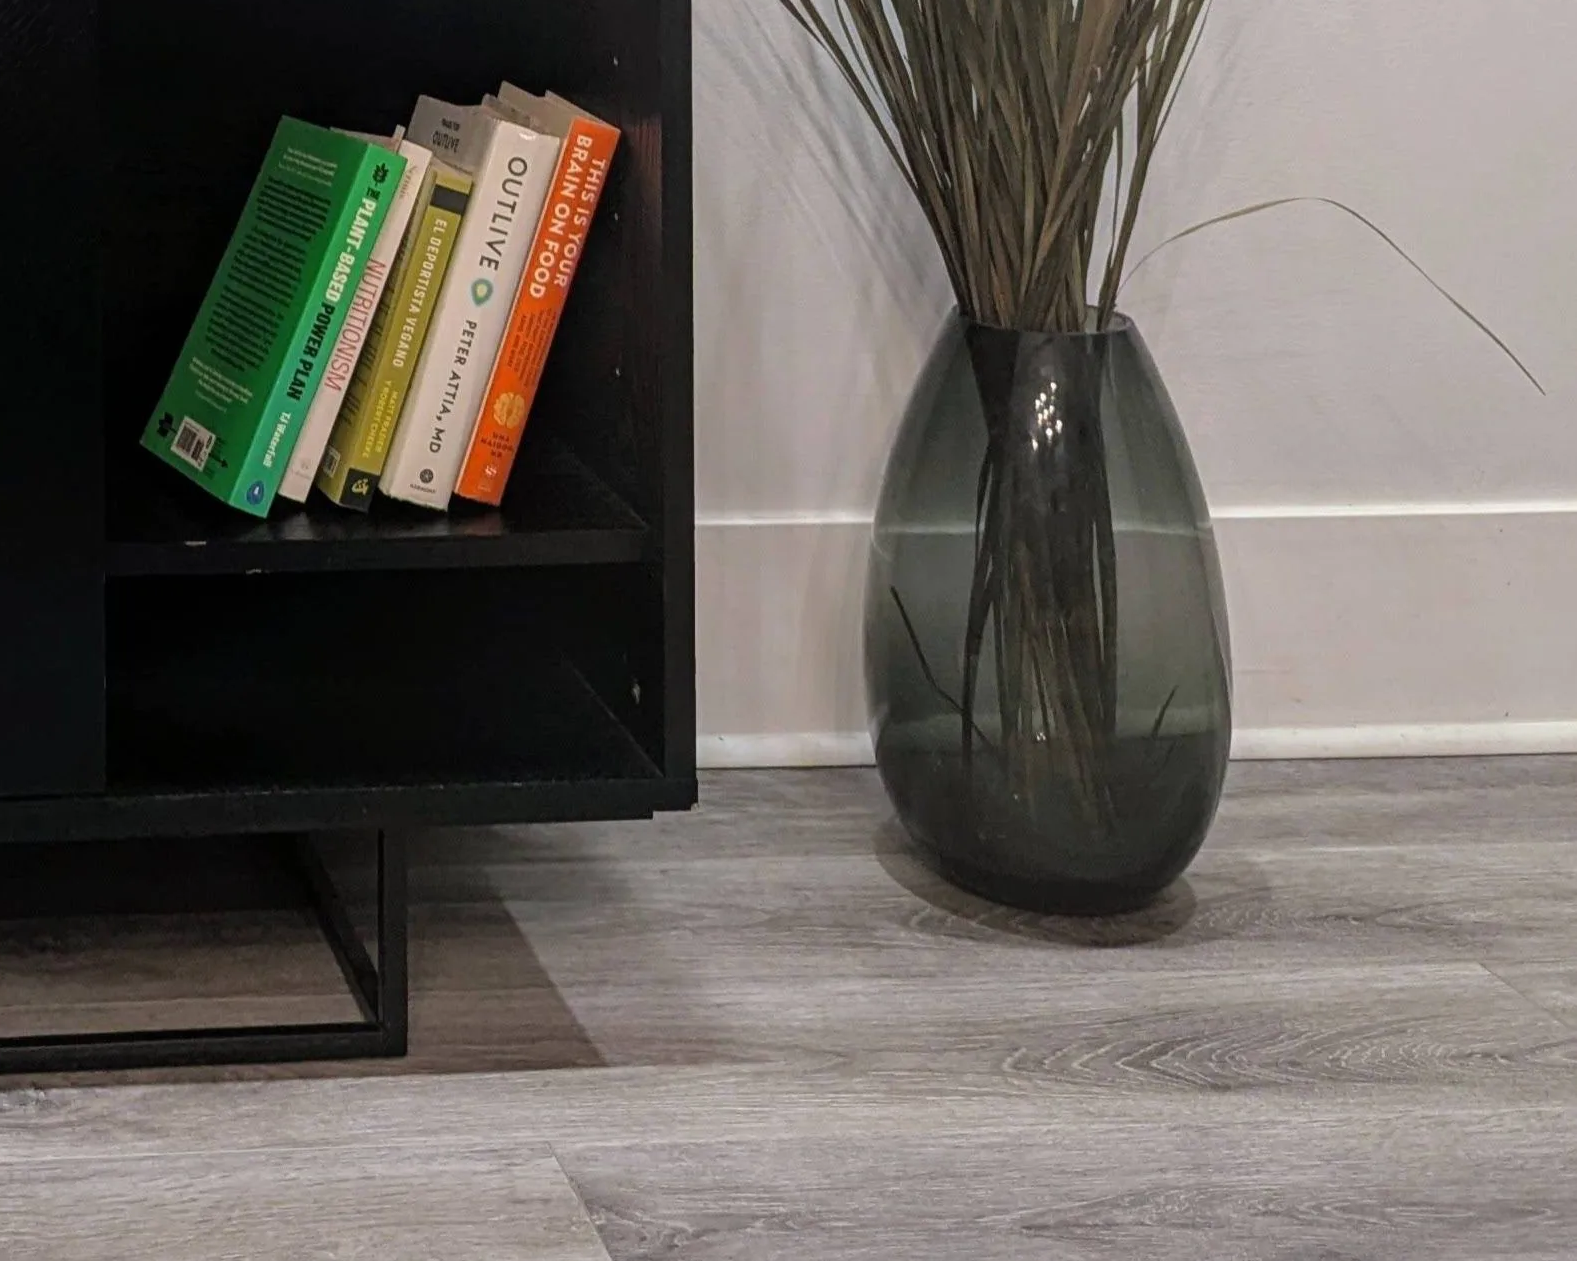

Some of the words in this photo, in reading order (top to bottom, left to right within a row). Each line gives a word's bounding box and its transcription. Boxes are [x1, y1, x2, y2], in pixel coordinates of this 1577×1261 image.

[561, 134, 593, 199] BRAIN
[581, 158, 606, 202] THIS
[433, 218, 447, 233] EL
[479, 156, 528, 271] OUTLIVE
[549, 203, 570, 235] ON
[574, 208, 590, 226] IS
[325, 197, 377, 302] PLANT-BASED
[529, 239, 560, 298] FOOD
[554, 233, 583, 287] YOUR
[408, 237, 442, 313] DEPORTISTA
[303, 302, 336, 359] POWER
[324, 257, 386, 391] NUTRITIONISM
[393, 318, 417, 368] VEGANO
[454, 320, 477, 366] PETER
[287, 358, 314, 401] PLAN
[436, 370, 461, 421] ATTIA,
[280, 412, 291, 423] TJ
[429, 427, 445, 453] MD
[263, 423, 286, 468] Waterfall
